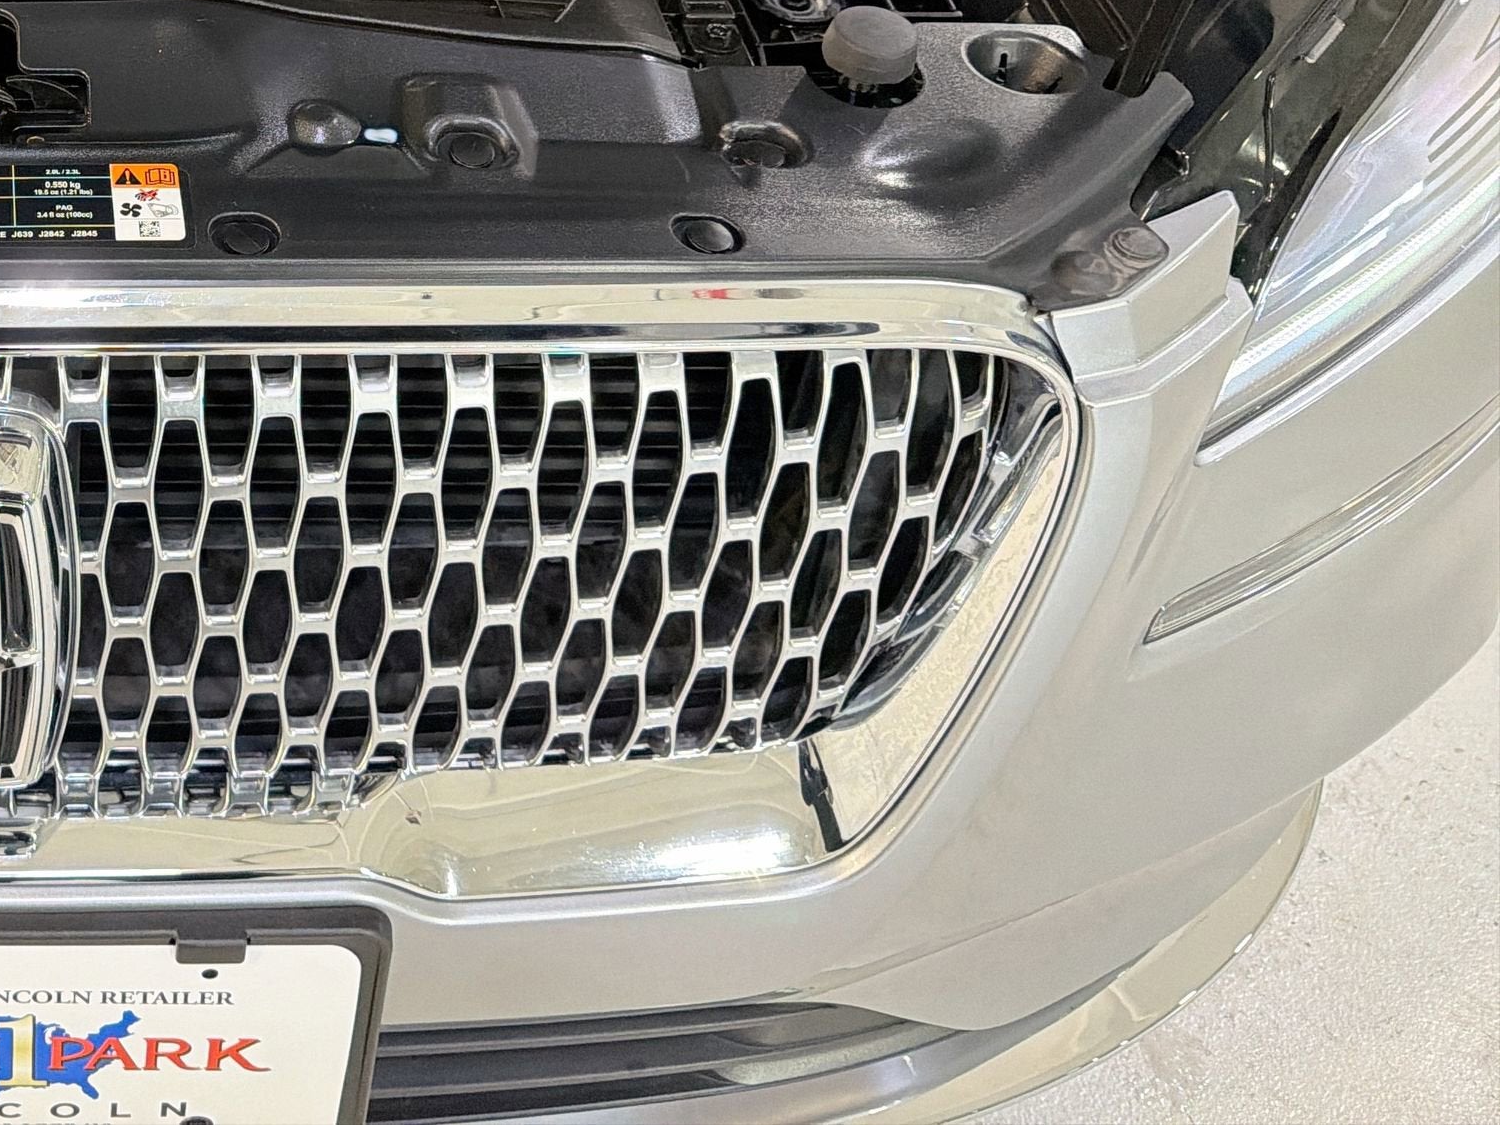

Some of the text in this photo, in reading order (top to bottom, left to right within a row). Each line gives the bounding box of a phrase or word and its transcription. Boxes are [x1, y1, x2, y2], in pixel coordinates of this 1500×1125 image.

[44, 180, 81, 190] 0.550 kg
[60, 188, 78, 196] (1.21
[78, 188, 93, 196] lbs)
[66, 211, 93, 219] (100cc)
[11, 230, 34, 238] J639
[38, 230, 65, 238] J2842
[71, 229, 98, 237] J2845
[99, 989, 235, 1006] RETAILER
[49, 1037, 273, 1073] PARK
